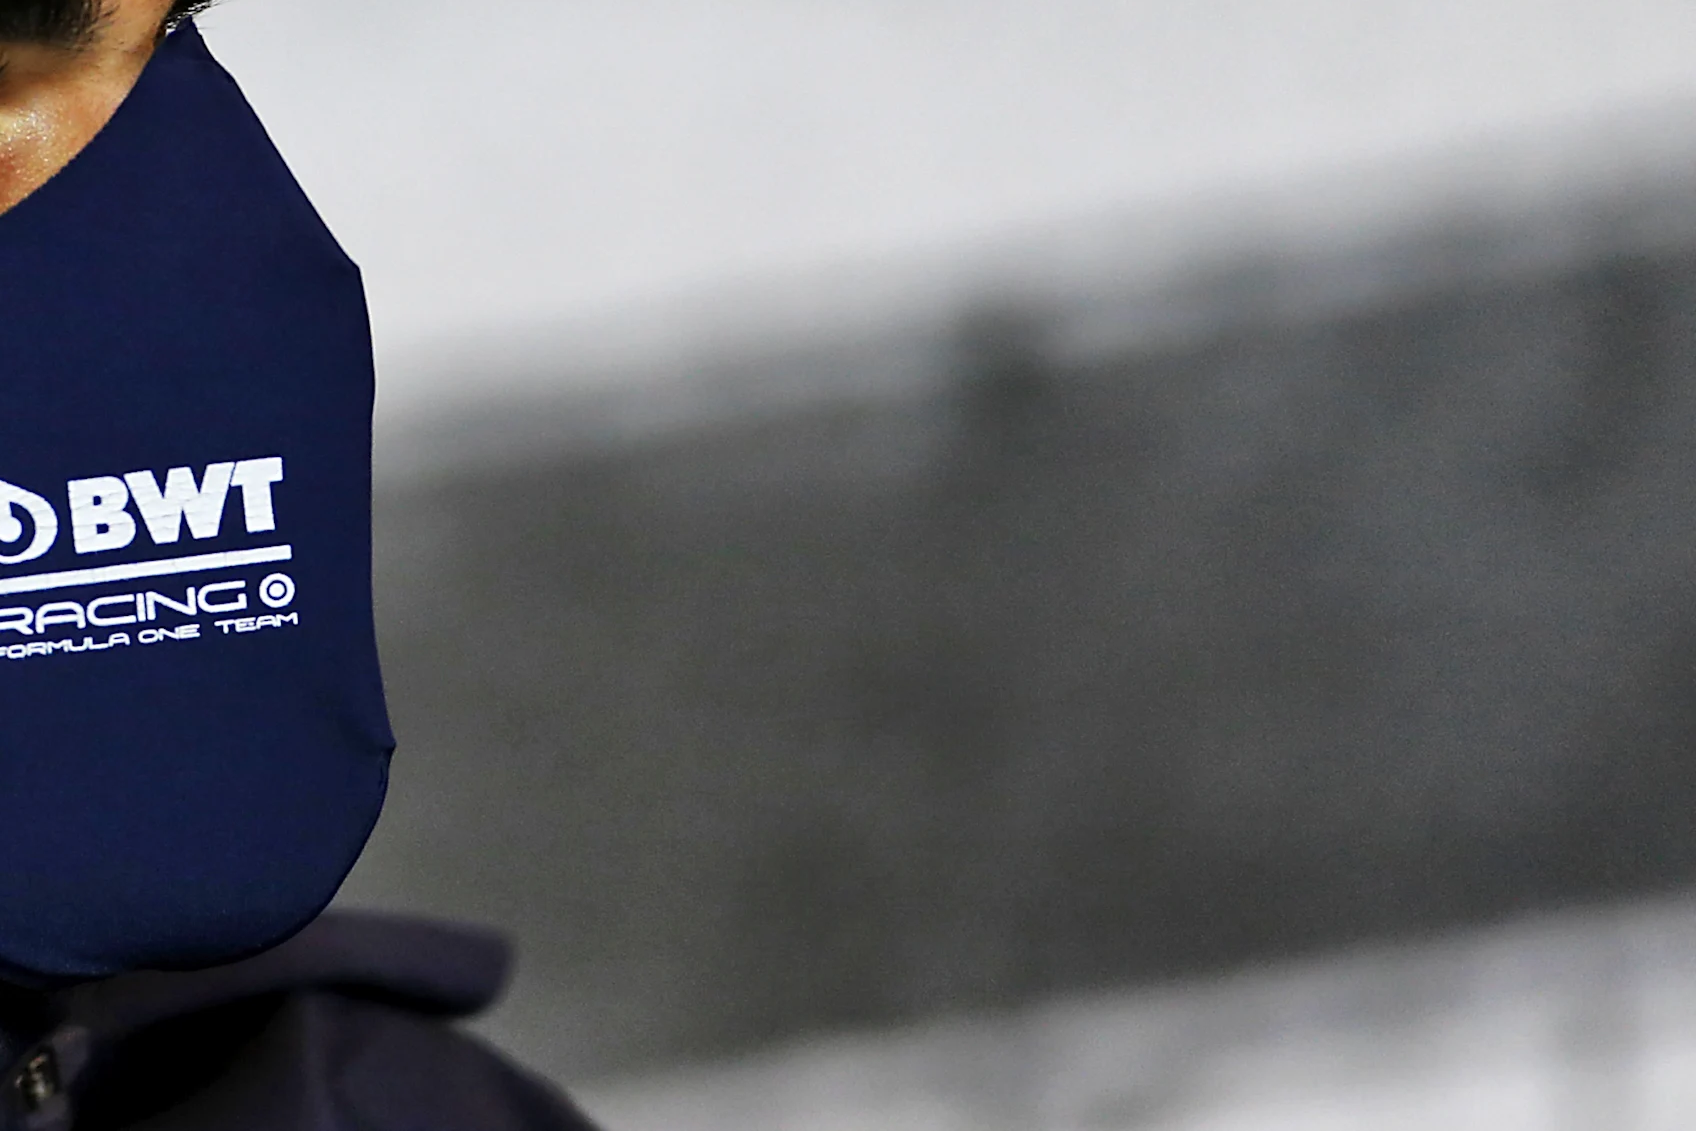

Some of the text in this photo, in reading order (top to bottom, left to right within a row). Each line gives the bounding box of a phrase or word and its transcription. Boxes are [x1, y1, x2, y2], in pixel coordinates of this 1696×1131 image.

[67, 456, 283, 554] BWT
[138, 623, 200, 645] ONE
[214, 611, 299, 635] TEAM
